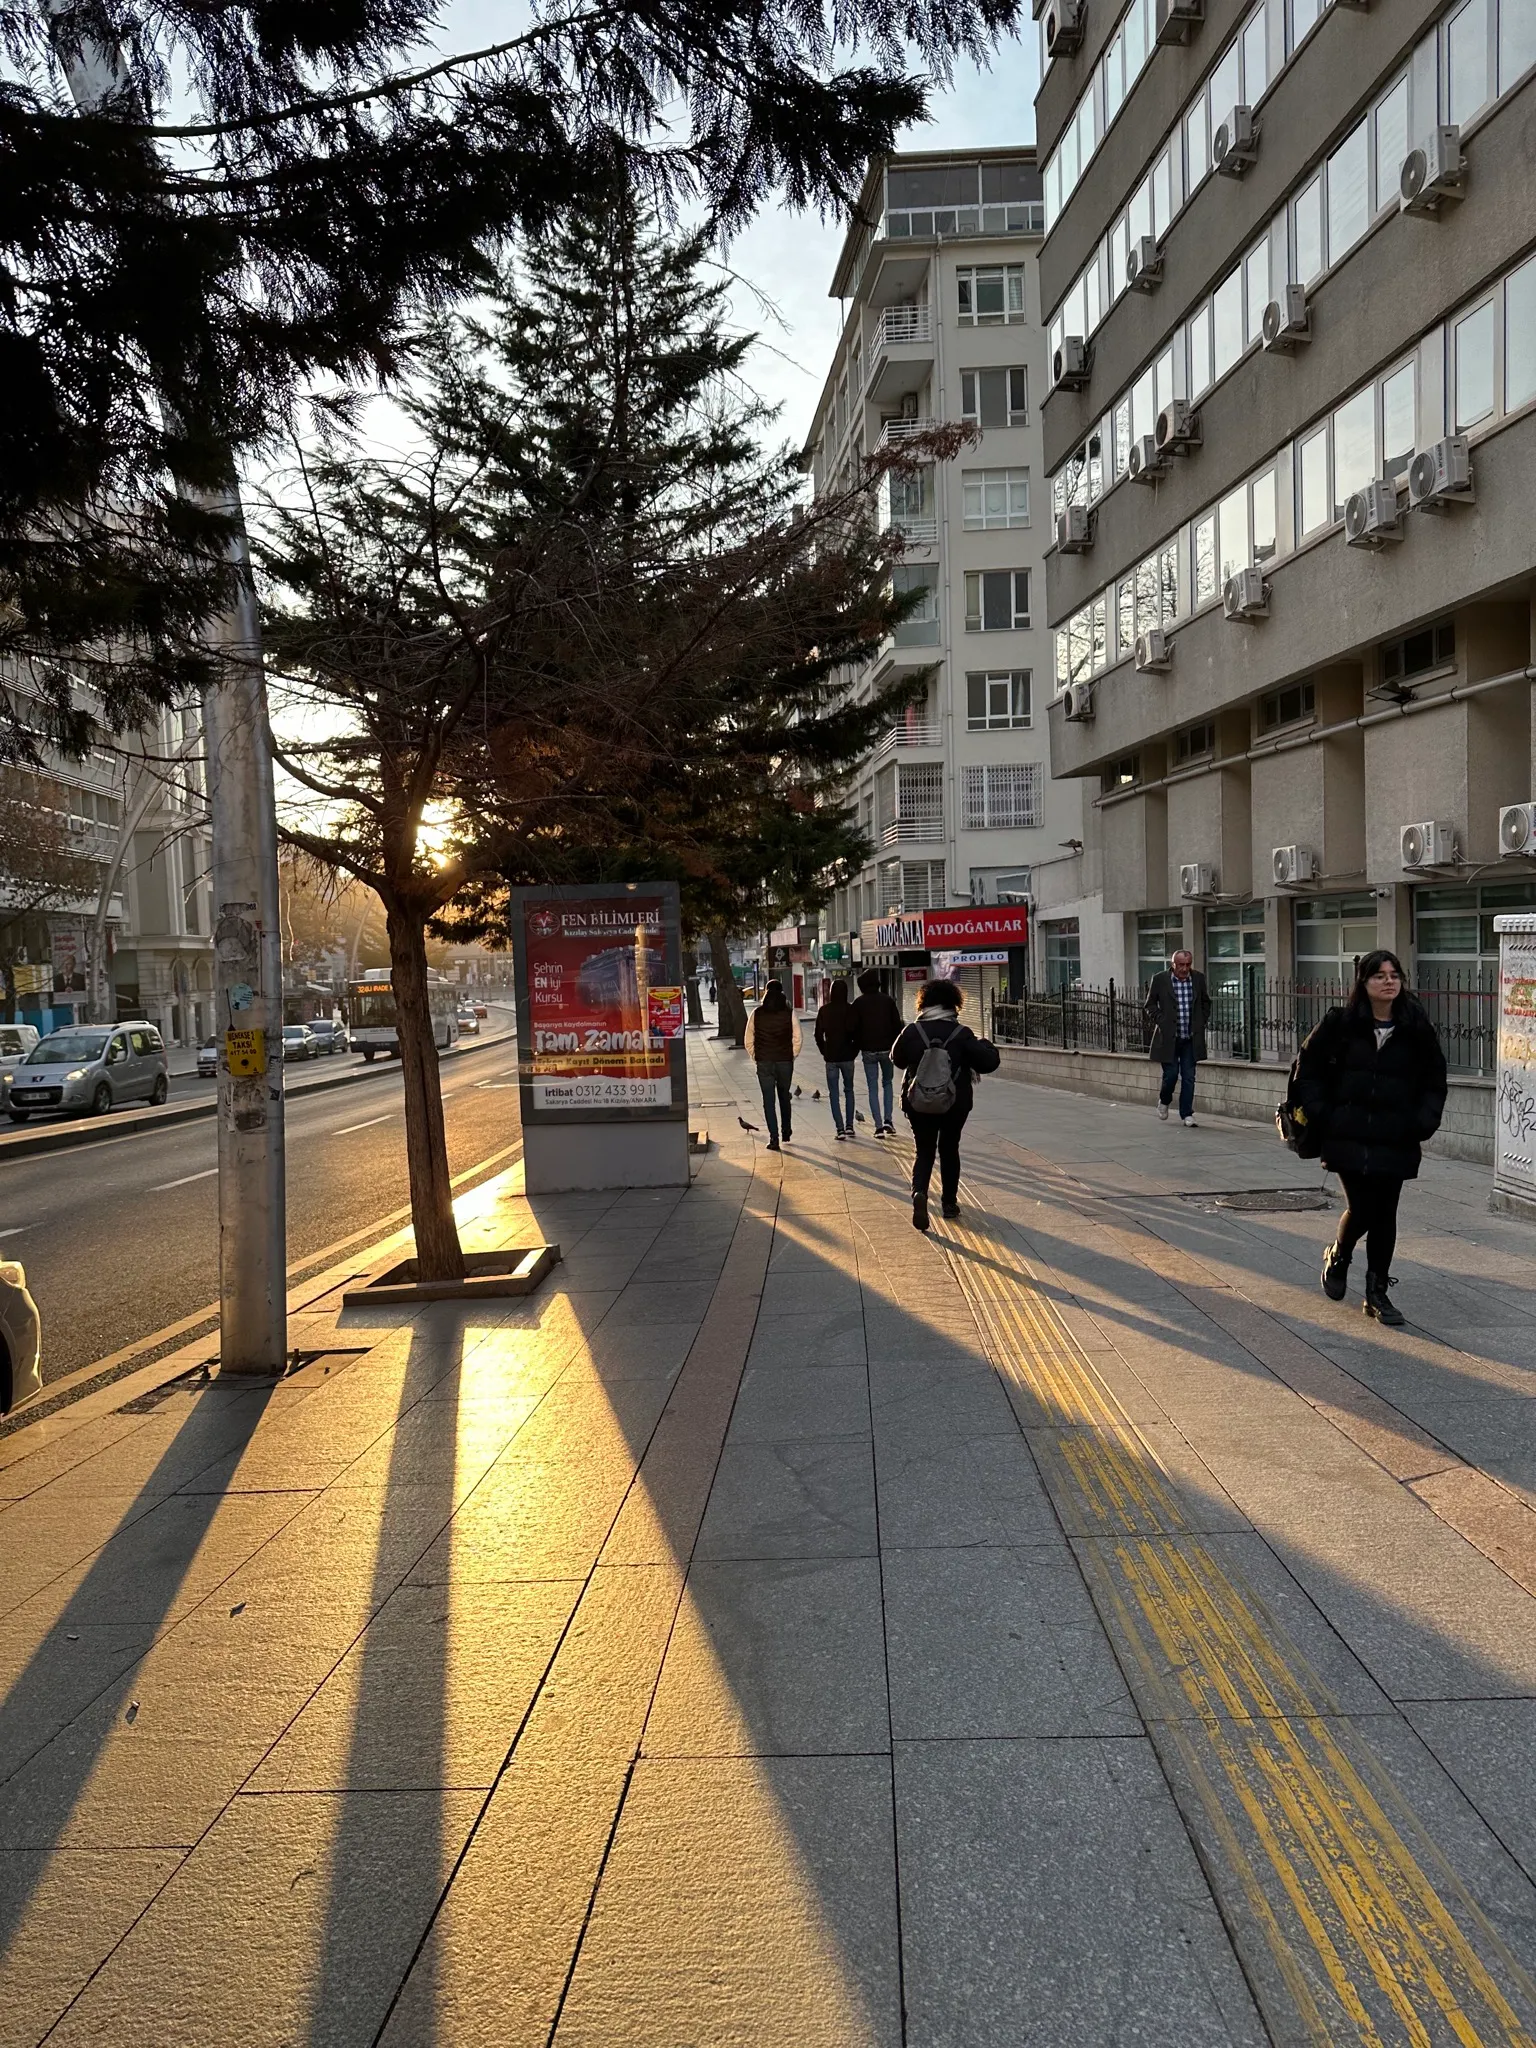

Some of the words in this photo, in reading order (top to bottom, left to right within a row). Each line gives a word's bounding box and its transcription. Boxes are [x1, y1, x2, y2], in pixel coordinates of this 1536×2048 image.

[562, 914, 587, 926] FEN
[591, 908, 660, 925] BİLİMLERİ
[926, 919, 1022, 936] AYDOĞANLAR
[533, 961, 563, 976] Şehrin
[535, 977, 548, 988] EN
[535, 992, 563, 1004] Kursu
[534, 1030, 579, 1053] Tam
[593, 1057, 627, 1065] Dönemi
[575, 1085, 602, 1096] 0312
[605, 1084, 627, 1095] 433
[630, 1084, 645, 1095] 99
[648, 1084, 657, 1095] 11
